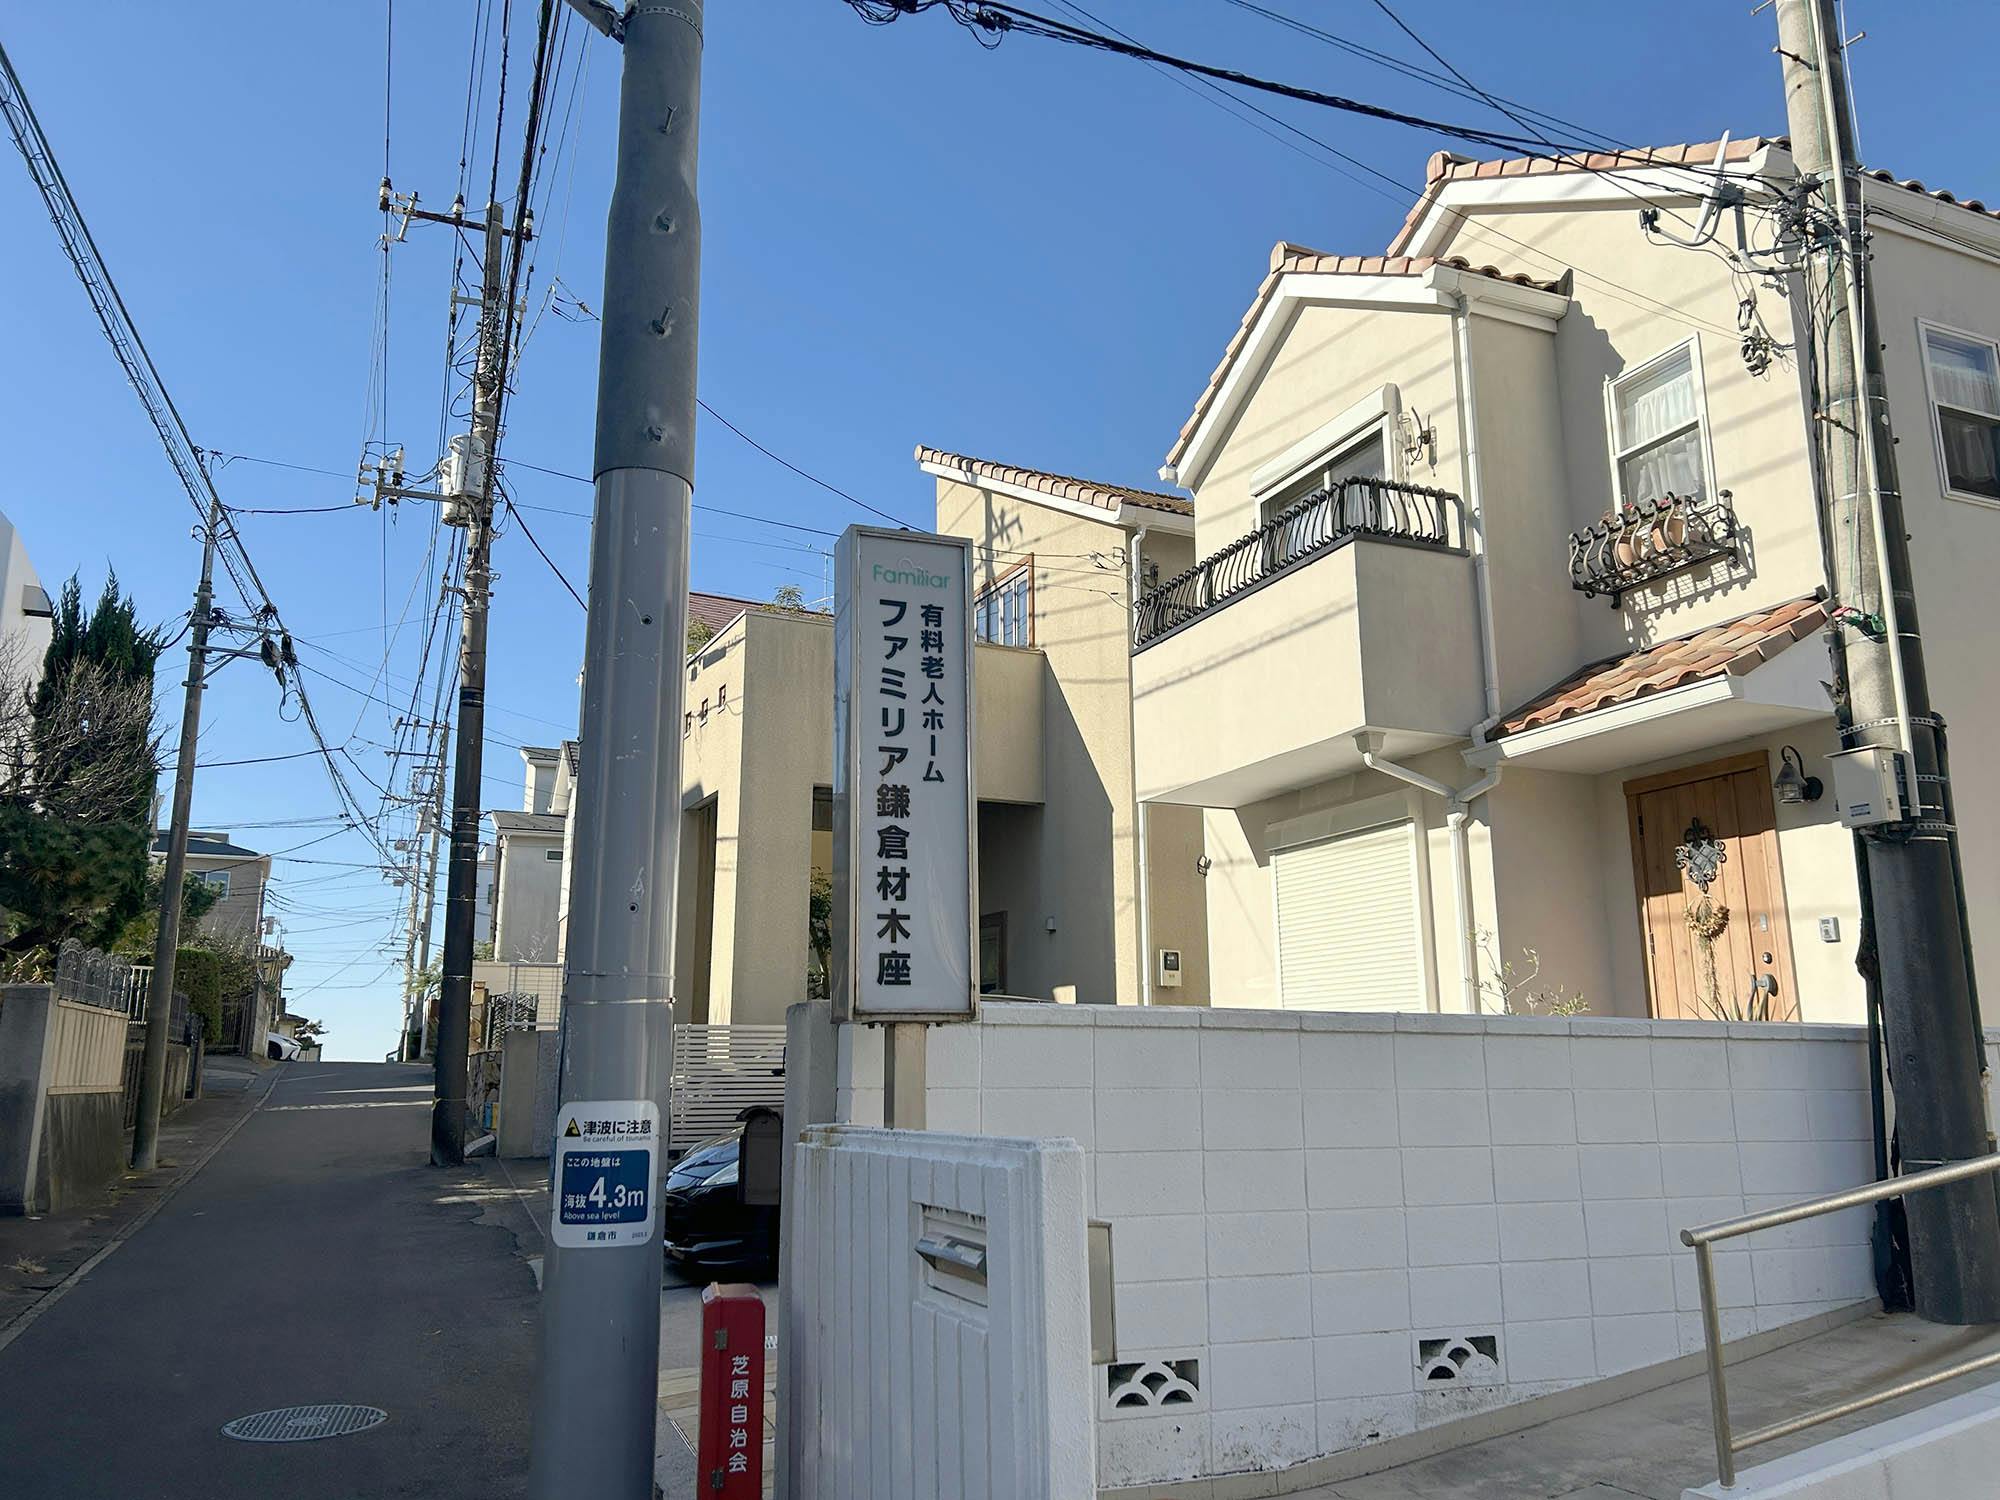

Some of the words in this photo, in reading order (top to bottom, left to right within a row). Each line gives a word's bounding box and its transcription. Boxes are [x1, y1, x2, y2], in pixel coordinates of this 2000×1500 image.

[873, 563, 951, 589] Familiar
[920, 603, 944, 784] 有料老人ホーム
[876, 598, 911, 986] ファミリア鎌倉材木座
[583, 1119, 652, 1136] 津波に注意
[592, 1135, 615, 1143] careful
[566, 1157, 621, 1168] ここの地盤は
[563, 1211, 585, 1220] Above
[601, 1211, 621, 1220] level
[728, 1355, 749, 1473] 芝原自治会
